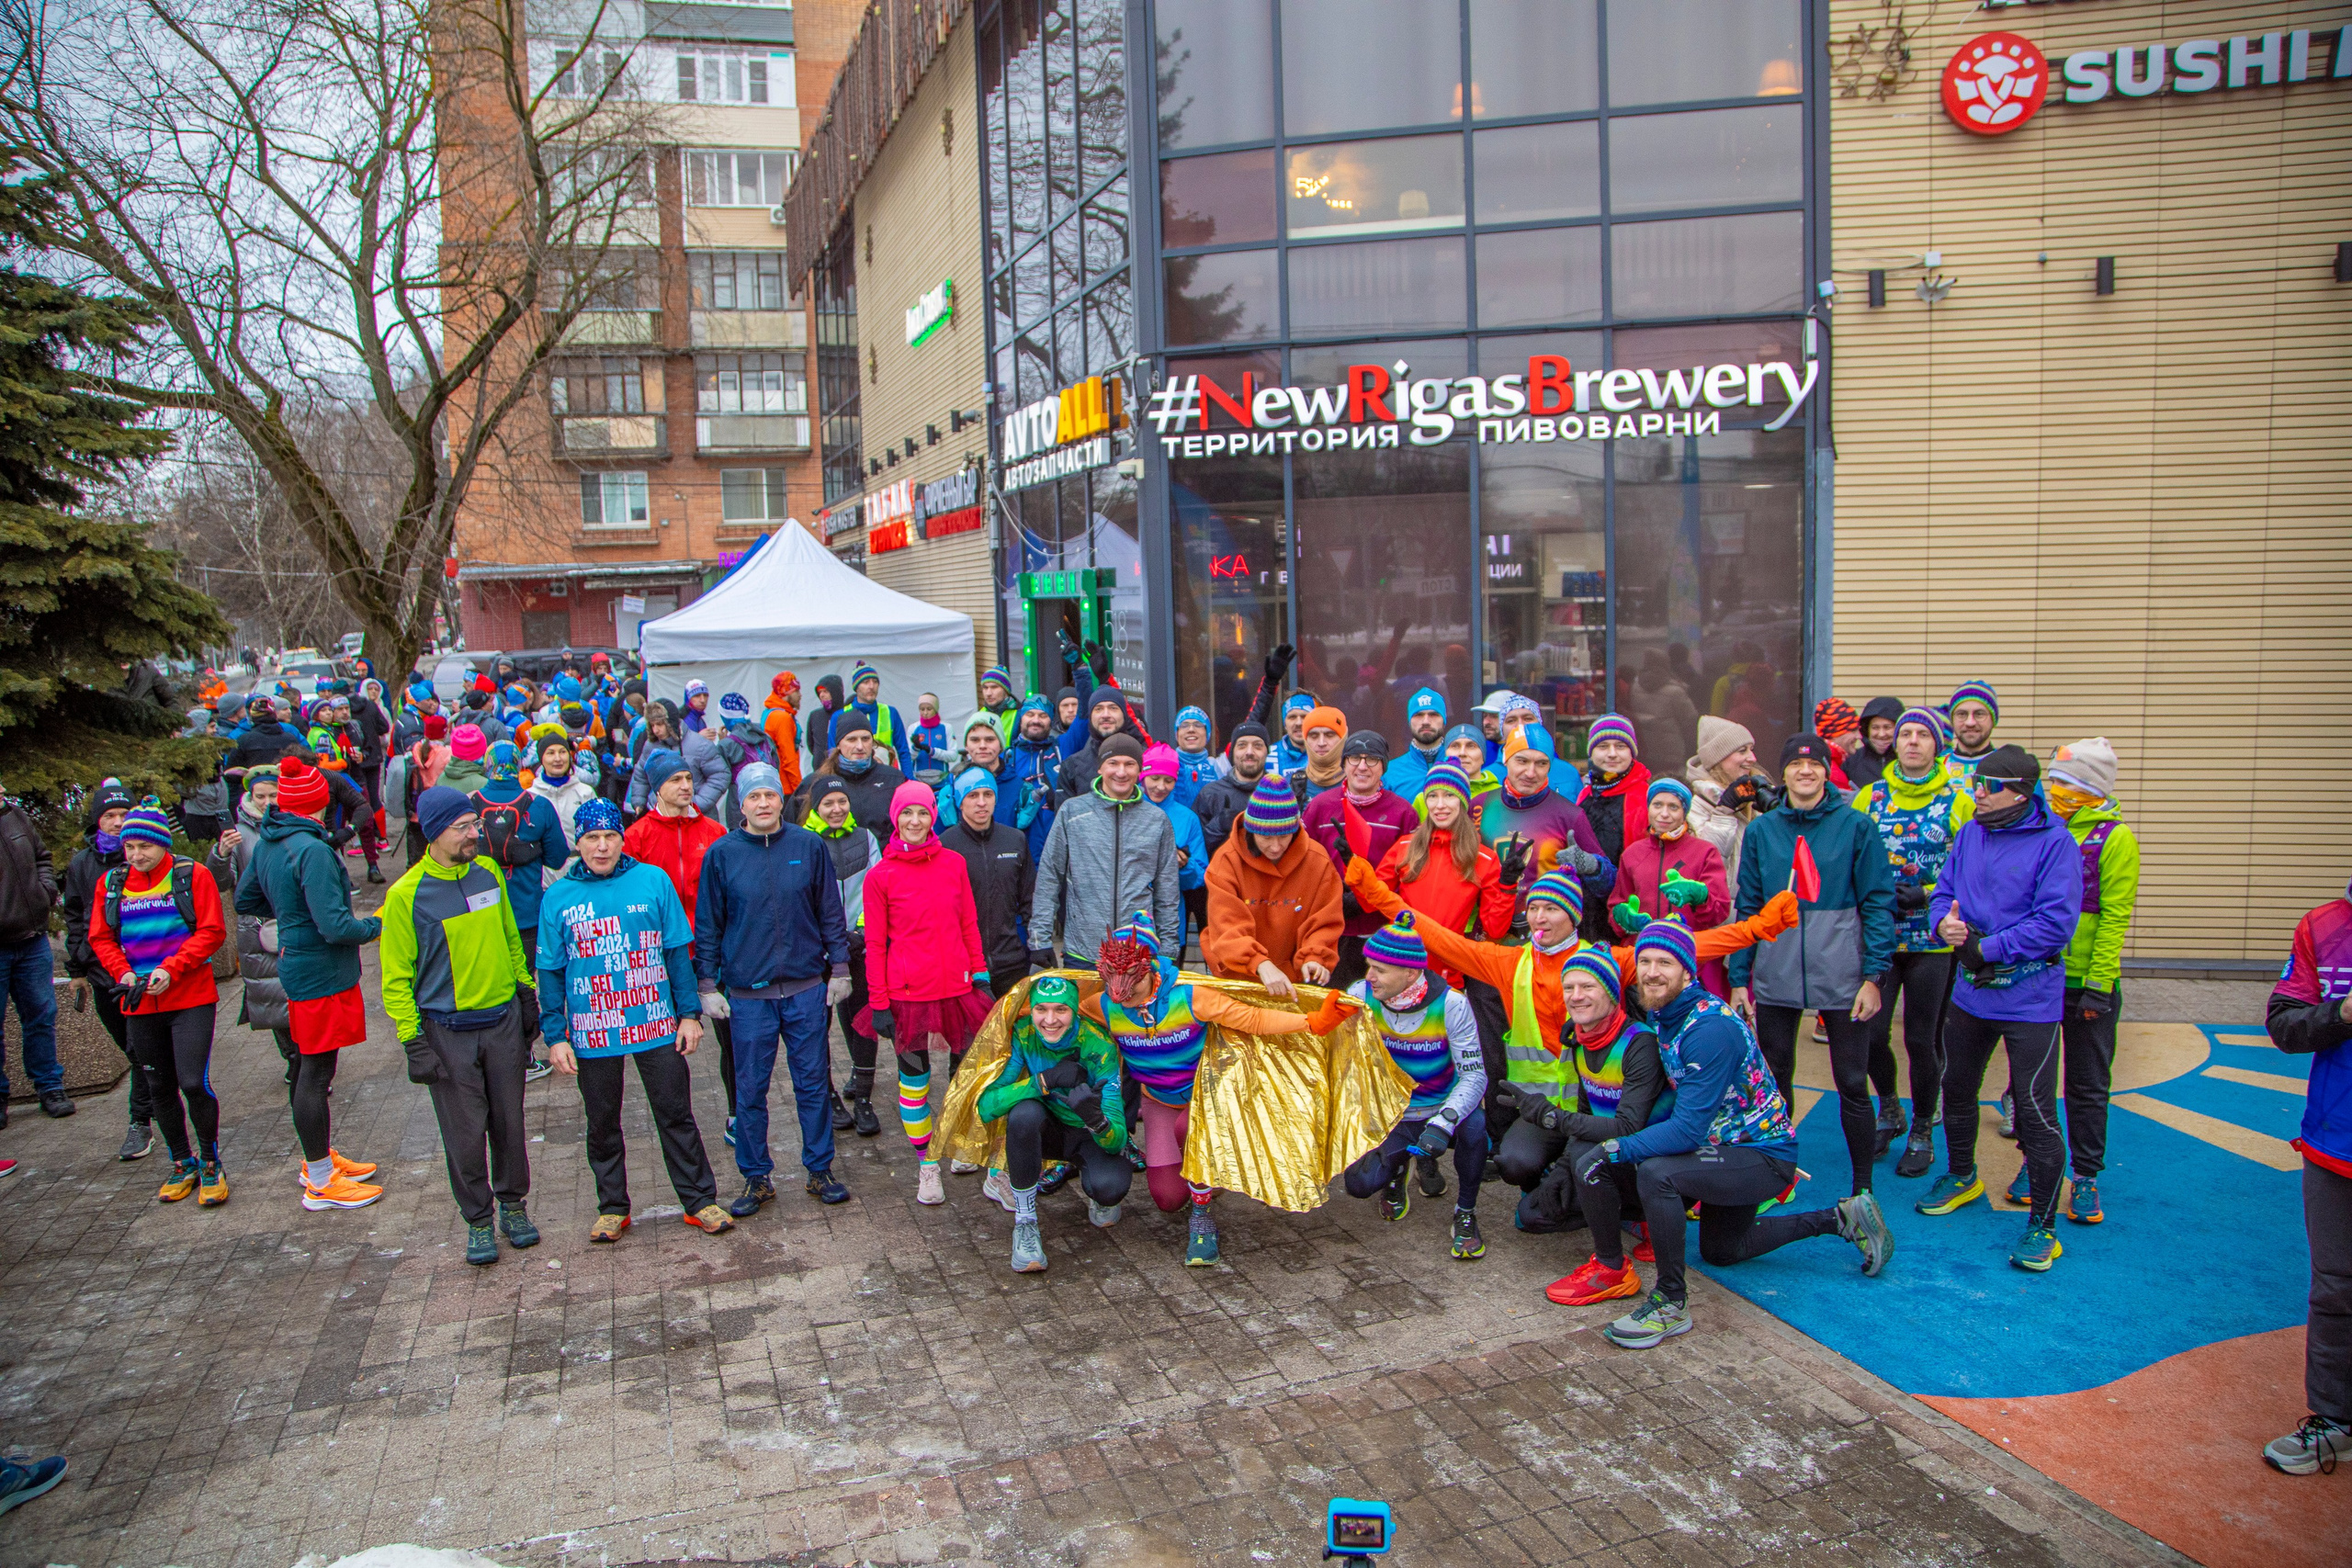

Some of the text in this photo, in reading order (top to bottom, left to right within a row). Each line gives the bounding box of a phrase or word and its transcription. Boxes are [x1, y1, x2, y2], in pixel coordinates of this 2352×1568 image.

[2063, 28, 2310, 104] SUSHI
[1148, 355, 1818, 446] #NewRigasBrewery
[1003, 377, 1110, 464] AVTOALL
[1161, 411, 1721, 457] ТЕРРИТОРИЯ ПИВОВАРНИ
[1004, 437, 1110, 492] АВТОЗАПЧАСТИ
[864, 478, 915, 526] ТАБАК
[562, 902, 595, 926] 2024
[571, 916, 622, 942] #МЕЧТА
[573, 974, 614, 996] #ЗАБЕГ
[589, 985, 660, 1012] #ГОРДОСТЬ
[571, 1009, 627, 1032] #ЛЮБОВЬ
[1118, 1028, 1191, 1047] #khimkirunbar
